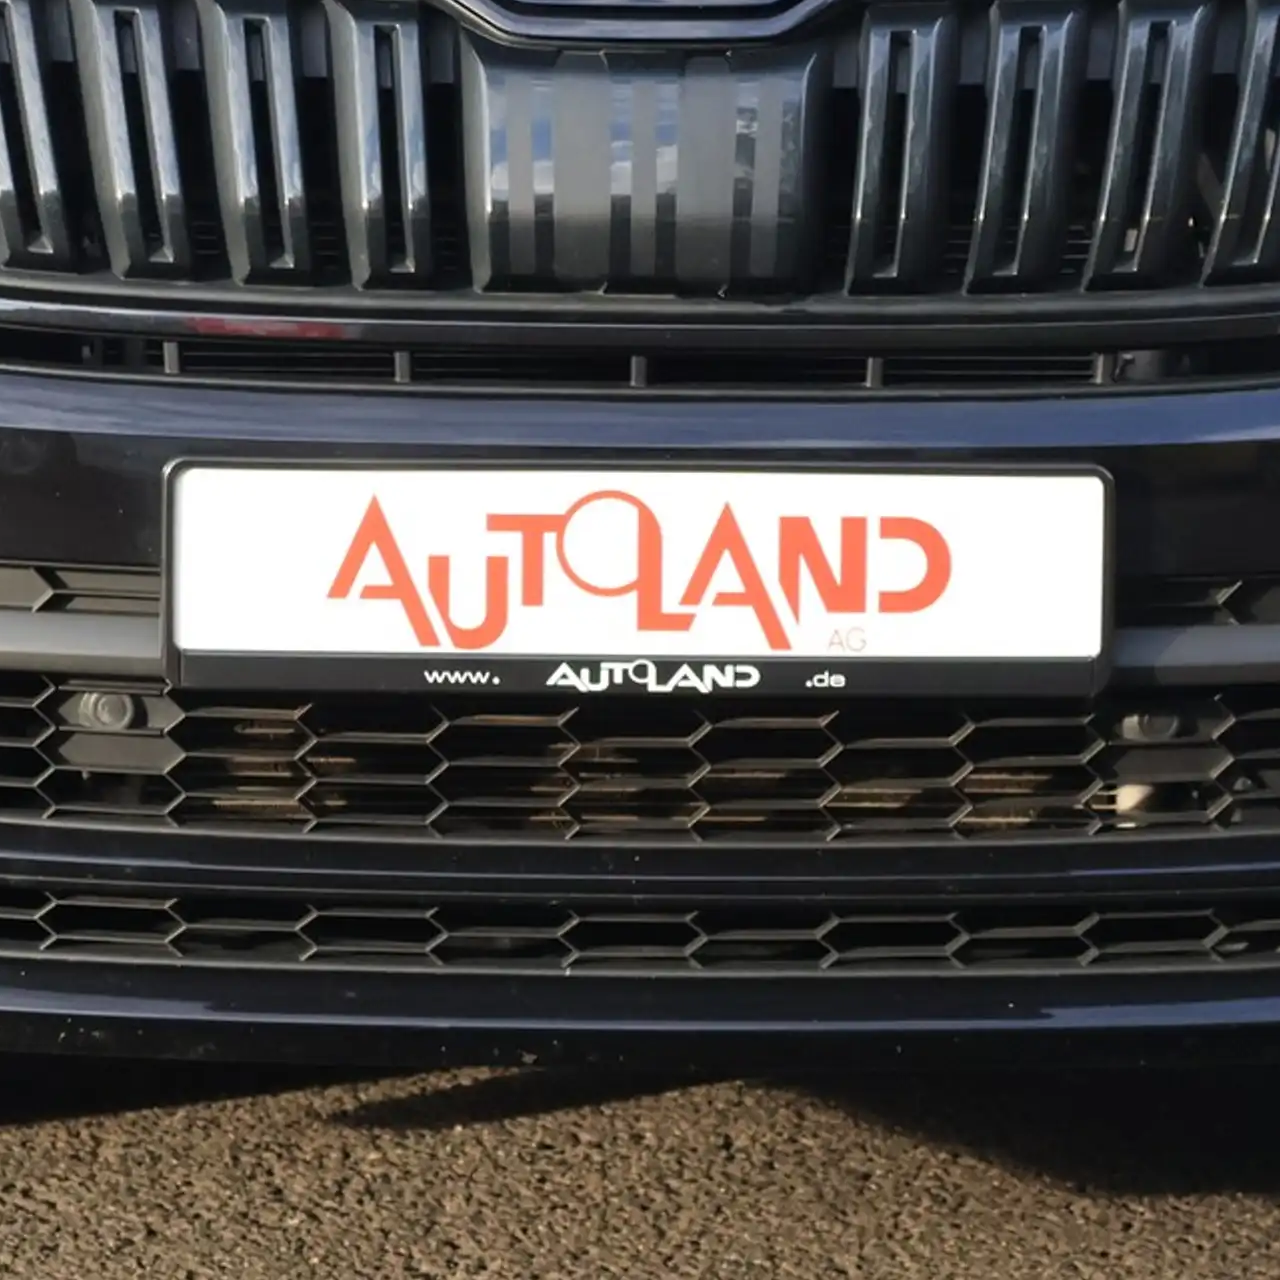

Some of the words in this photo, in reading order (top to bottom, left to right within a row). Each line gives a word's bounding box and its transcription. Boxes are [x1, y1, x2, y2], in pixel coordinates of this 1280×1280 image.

[326, 490, 952, 650] AUTOLAND
[827, 627, 868, 652] AG
[424, 670, 501, 685] www.
[546, 659, 761, 692] AUTOLAND
[805, 671, 846, 688] .de
